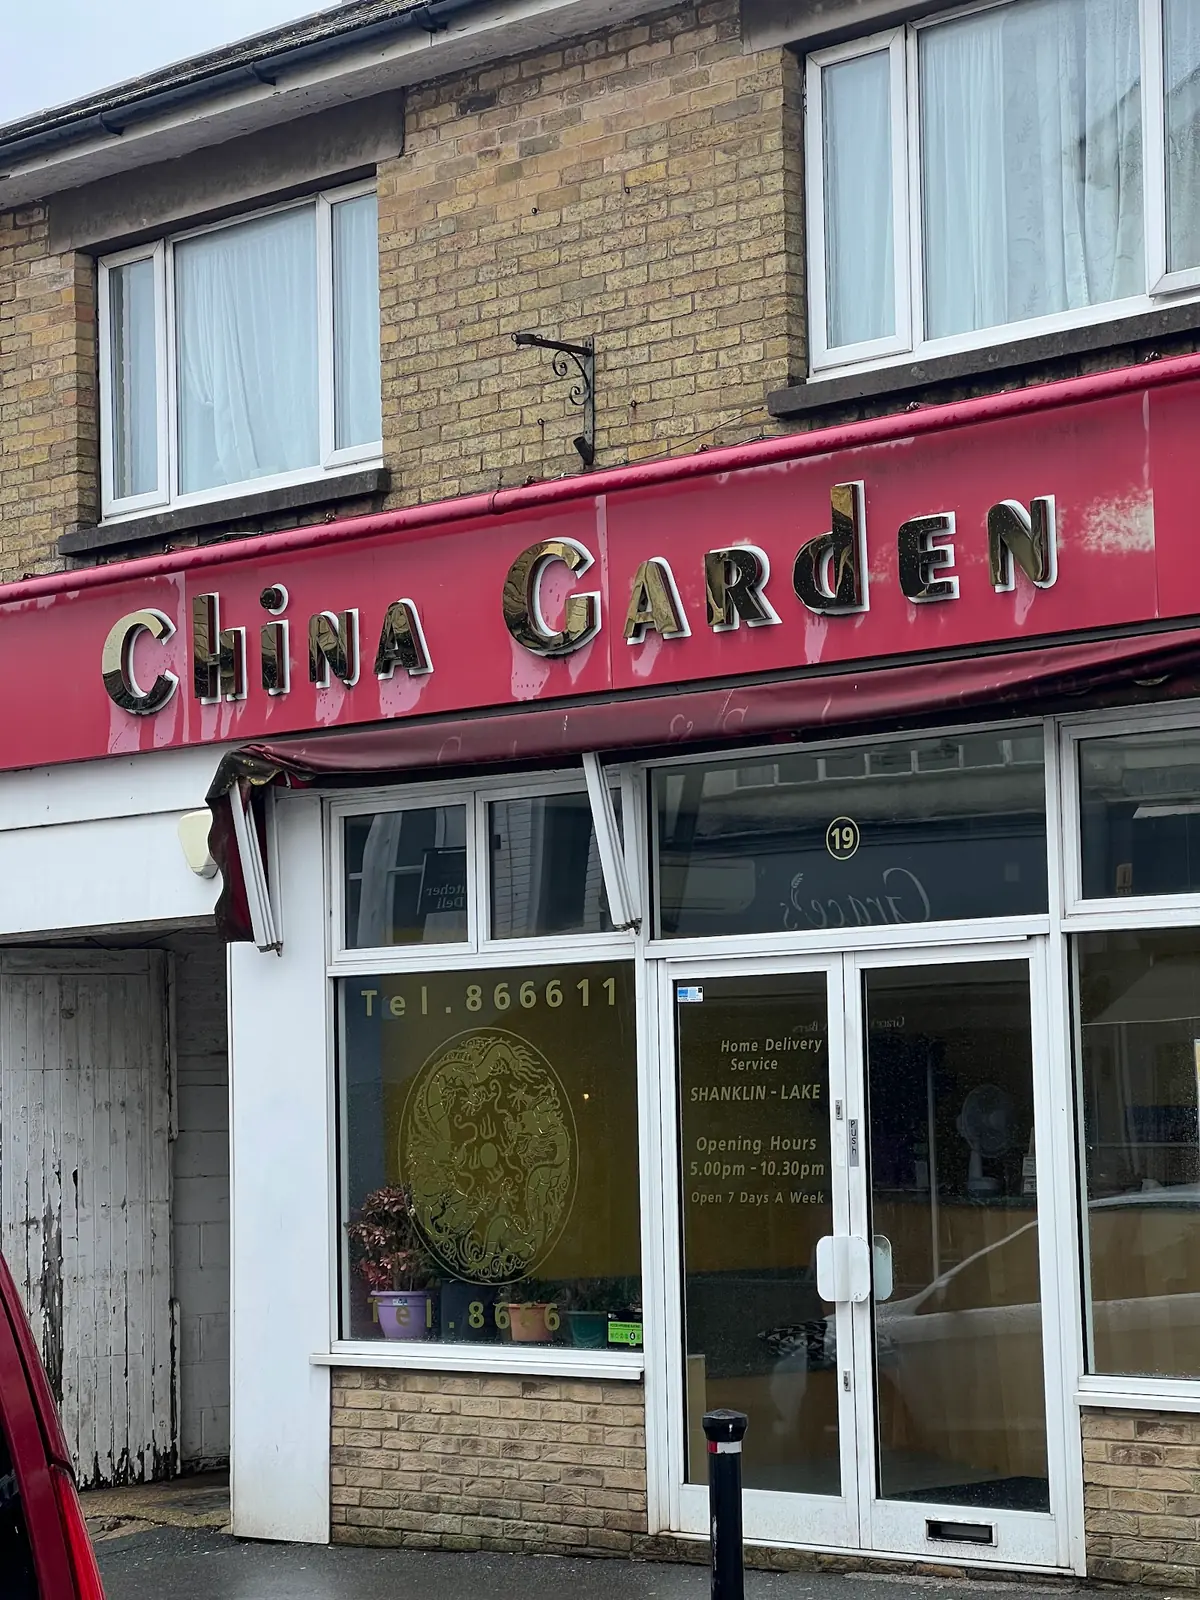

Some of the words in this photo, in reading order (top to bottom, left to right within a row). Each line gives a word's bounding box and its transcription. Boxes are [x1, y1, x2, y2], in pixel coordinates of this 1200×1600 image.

[830, 826, 854, 850] 19
[721, 1039, 758, 1053] Home
[765, 1037, 822, 1052] Delivery
[730, 1057, 778, 1071] Service
[696, 1135, 762, 1154] Opening
[770, 1135, 817, 1151] Hours
[691, 1191, 722, 1206] Open
[728, 1191, 735, 1204] 7
[740, 1191, 769, 1206] Days
[775, 1191, 784, 1203] A
[790, 1191, 825, 1204] Week
